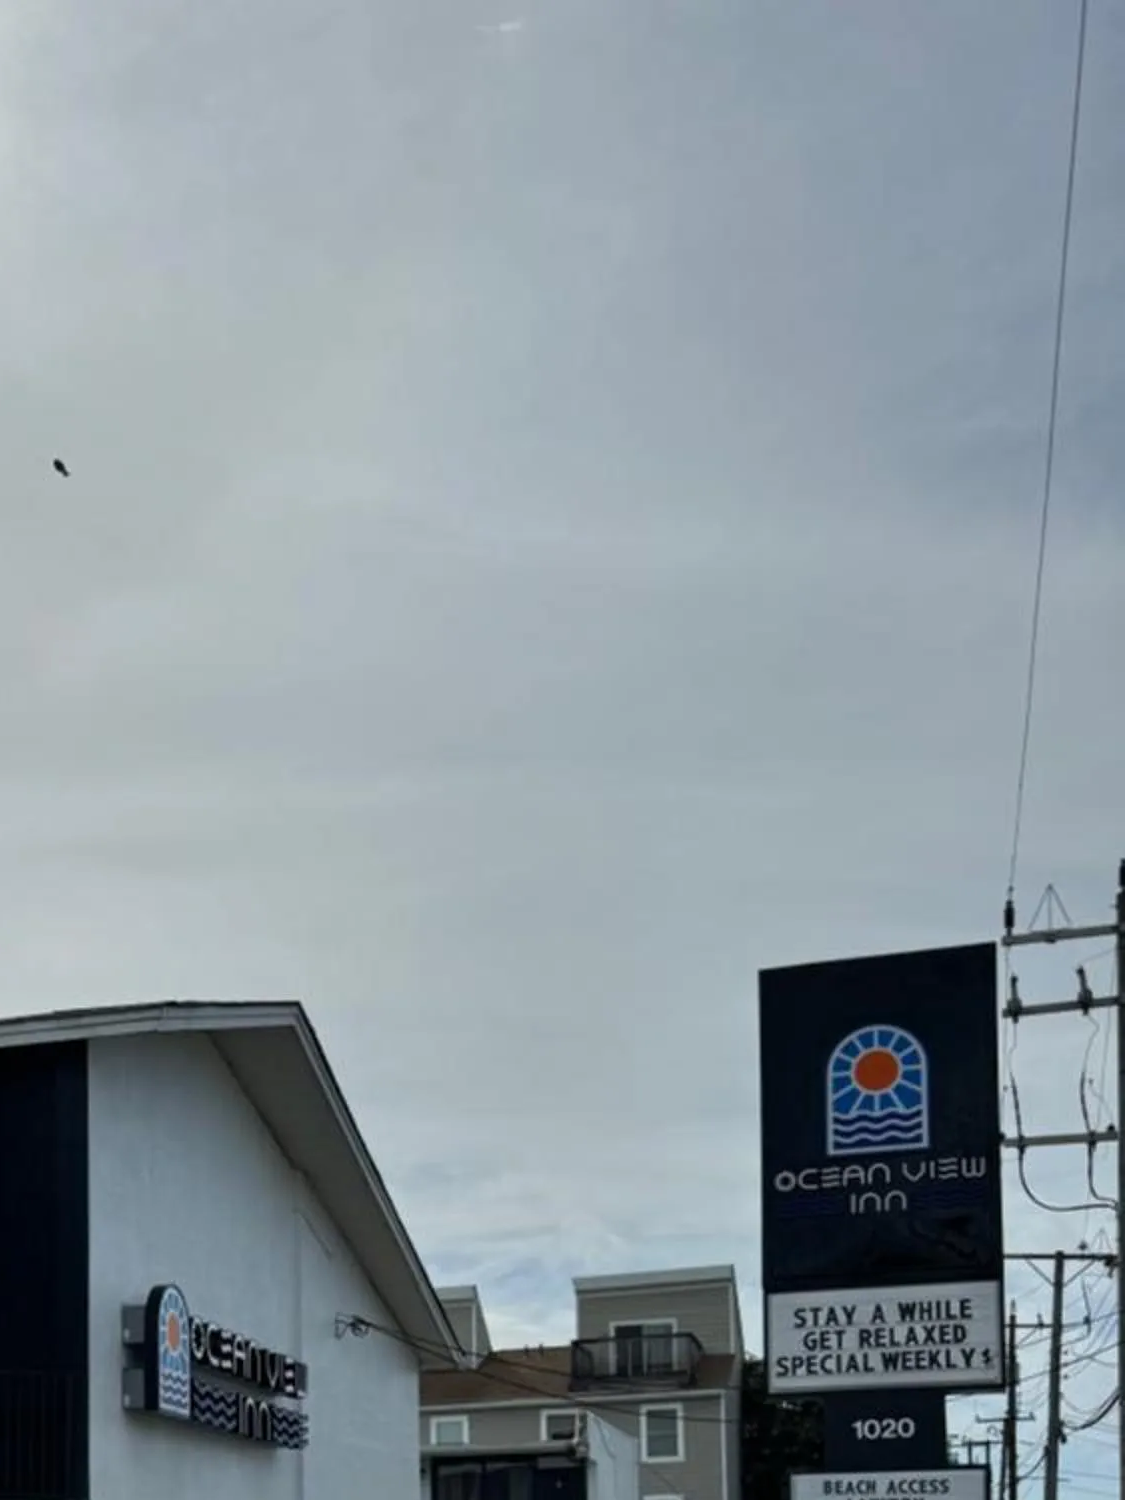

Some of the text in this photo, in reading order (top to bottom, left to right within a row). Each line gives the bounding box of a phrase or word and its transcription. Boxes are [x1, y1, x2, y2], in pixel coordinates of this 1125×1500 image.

[775, 1157, 986, 1192] OCEAN VIEW
[850, 1190, 907, 1215] INN
[793, 1299, 973, 1328] STAY A WHILE
[803, 1324, 967, 1351] GET RELAXED
[776, 1353, 874, 1377] SPECIAL
[851, 1417, 915, 1440] 1020
[823, 1479, 951, 1496] BEACH ACCESS
